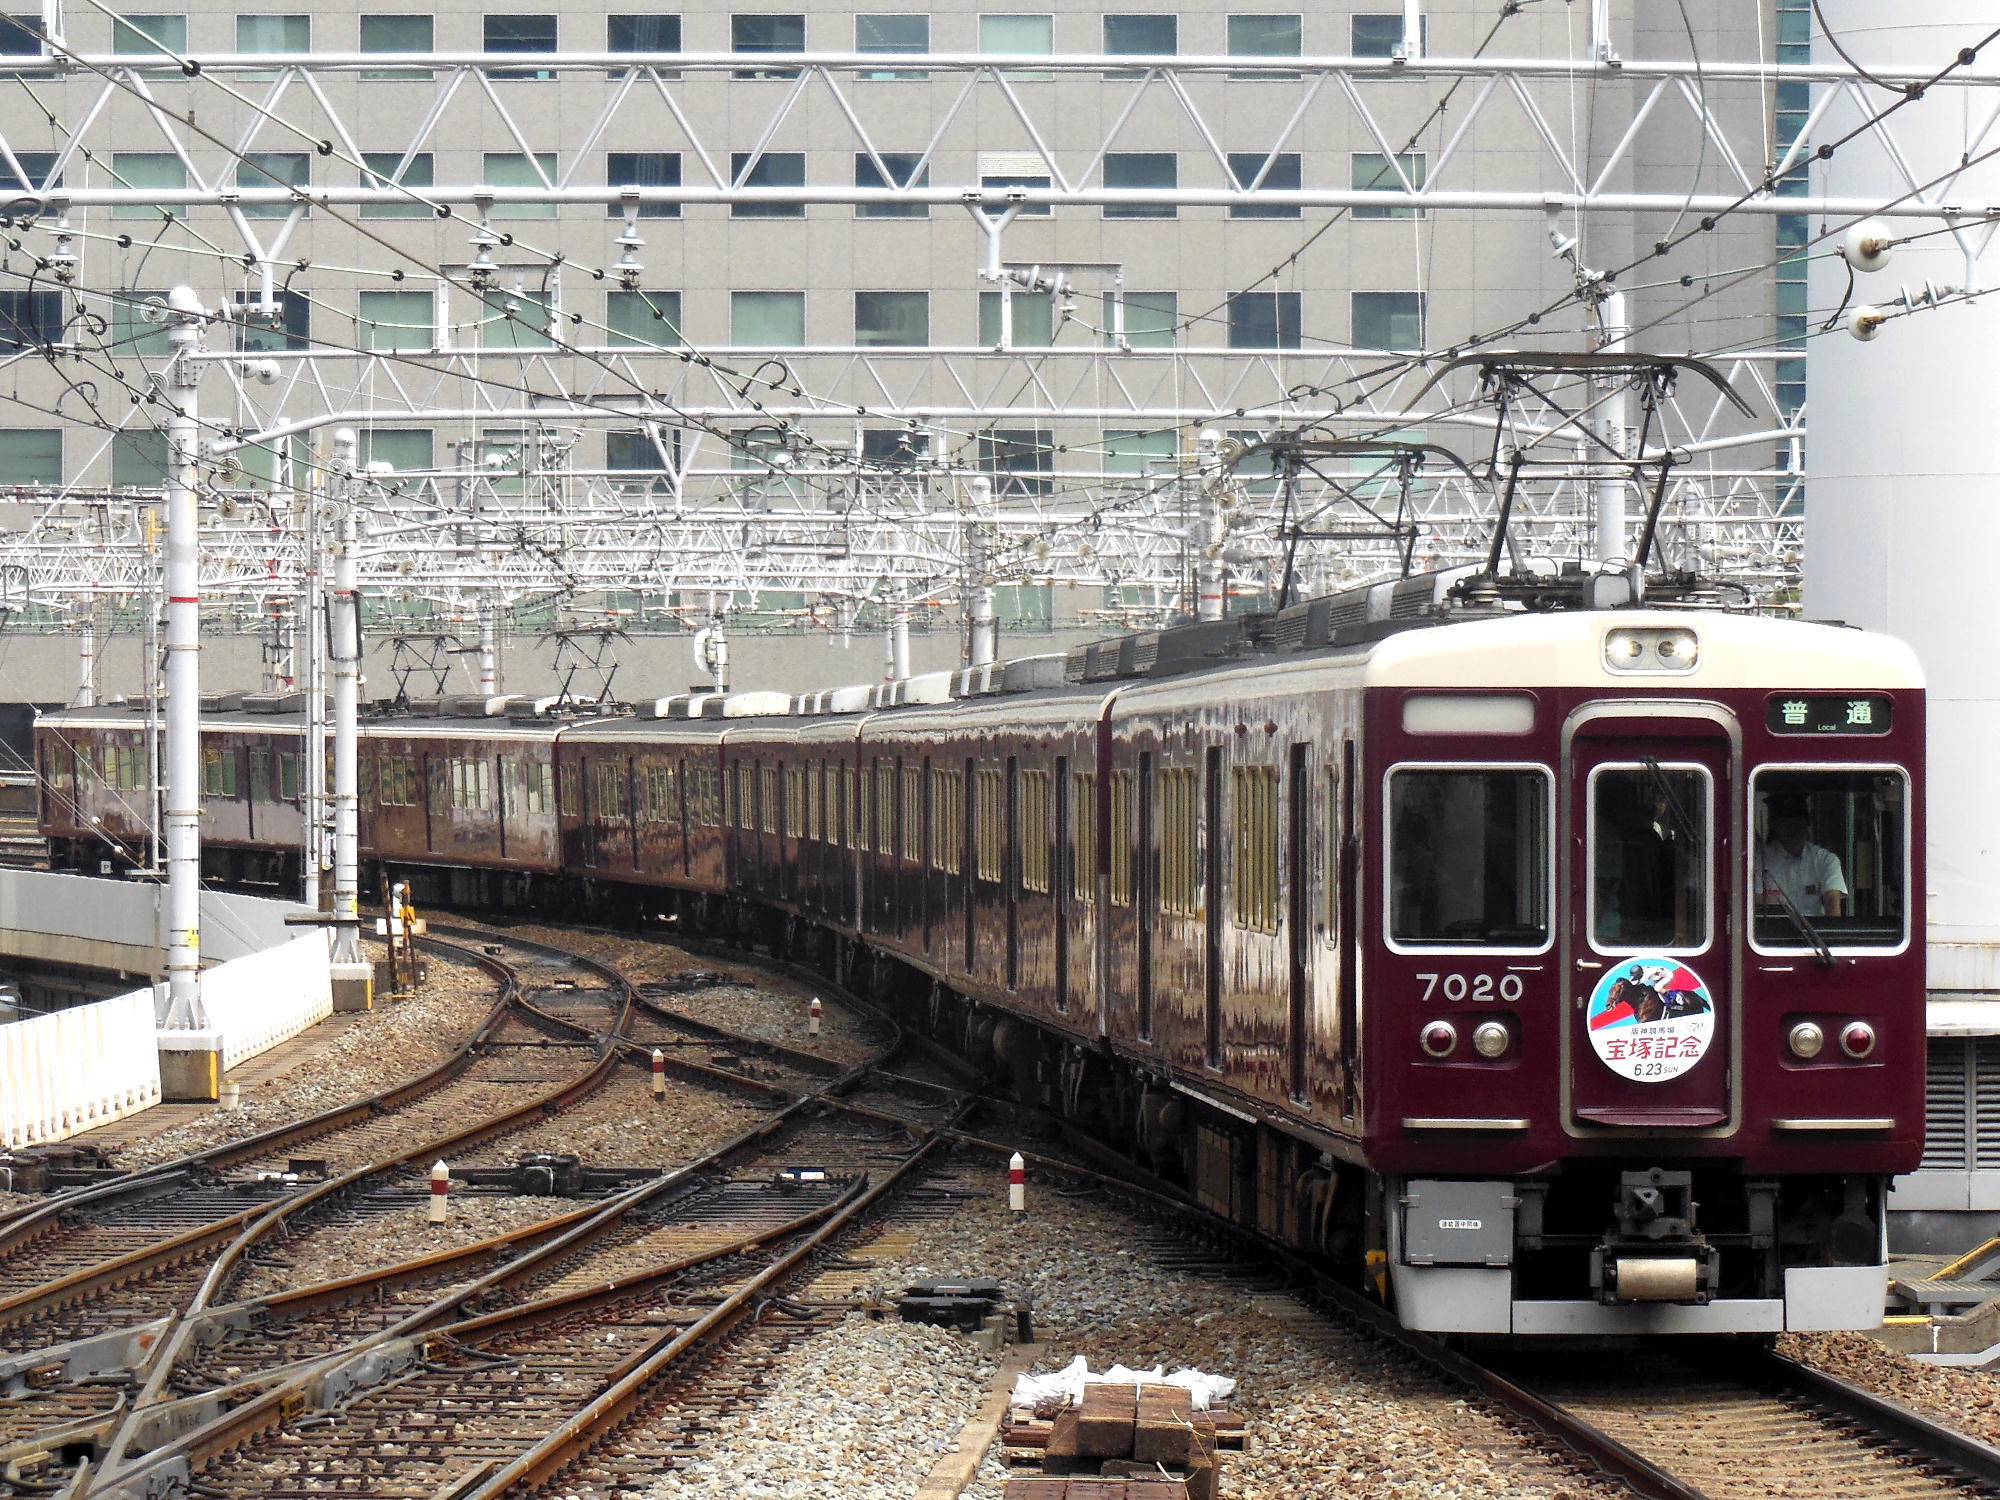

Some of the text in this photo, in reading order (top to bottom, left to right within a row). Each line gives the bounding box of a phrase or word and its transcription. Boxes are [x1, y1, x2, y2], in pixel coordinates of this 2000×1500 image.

[1782, 701, 1872, 724] 普通
[1416, 973, 1523, 1001] 7020
[1606, 1035, 1702, 1060] 宝塚記念
[1634, 1063, 1662, 1076] 6.23
